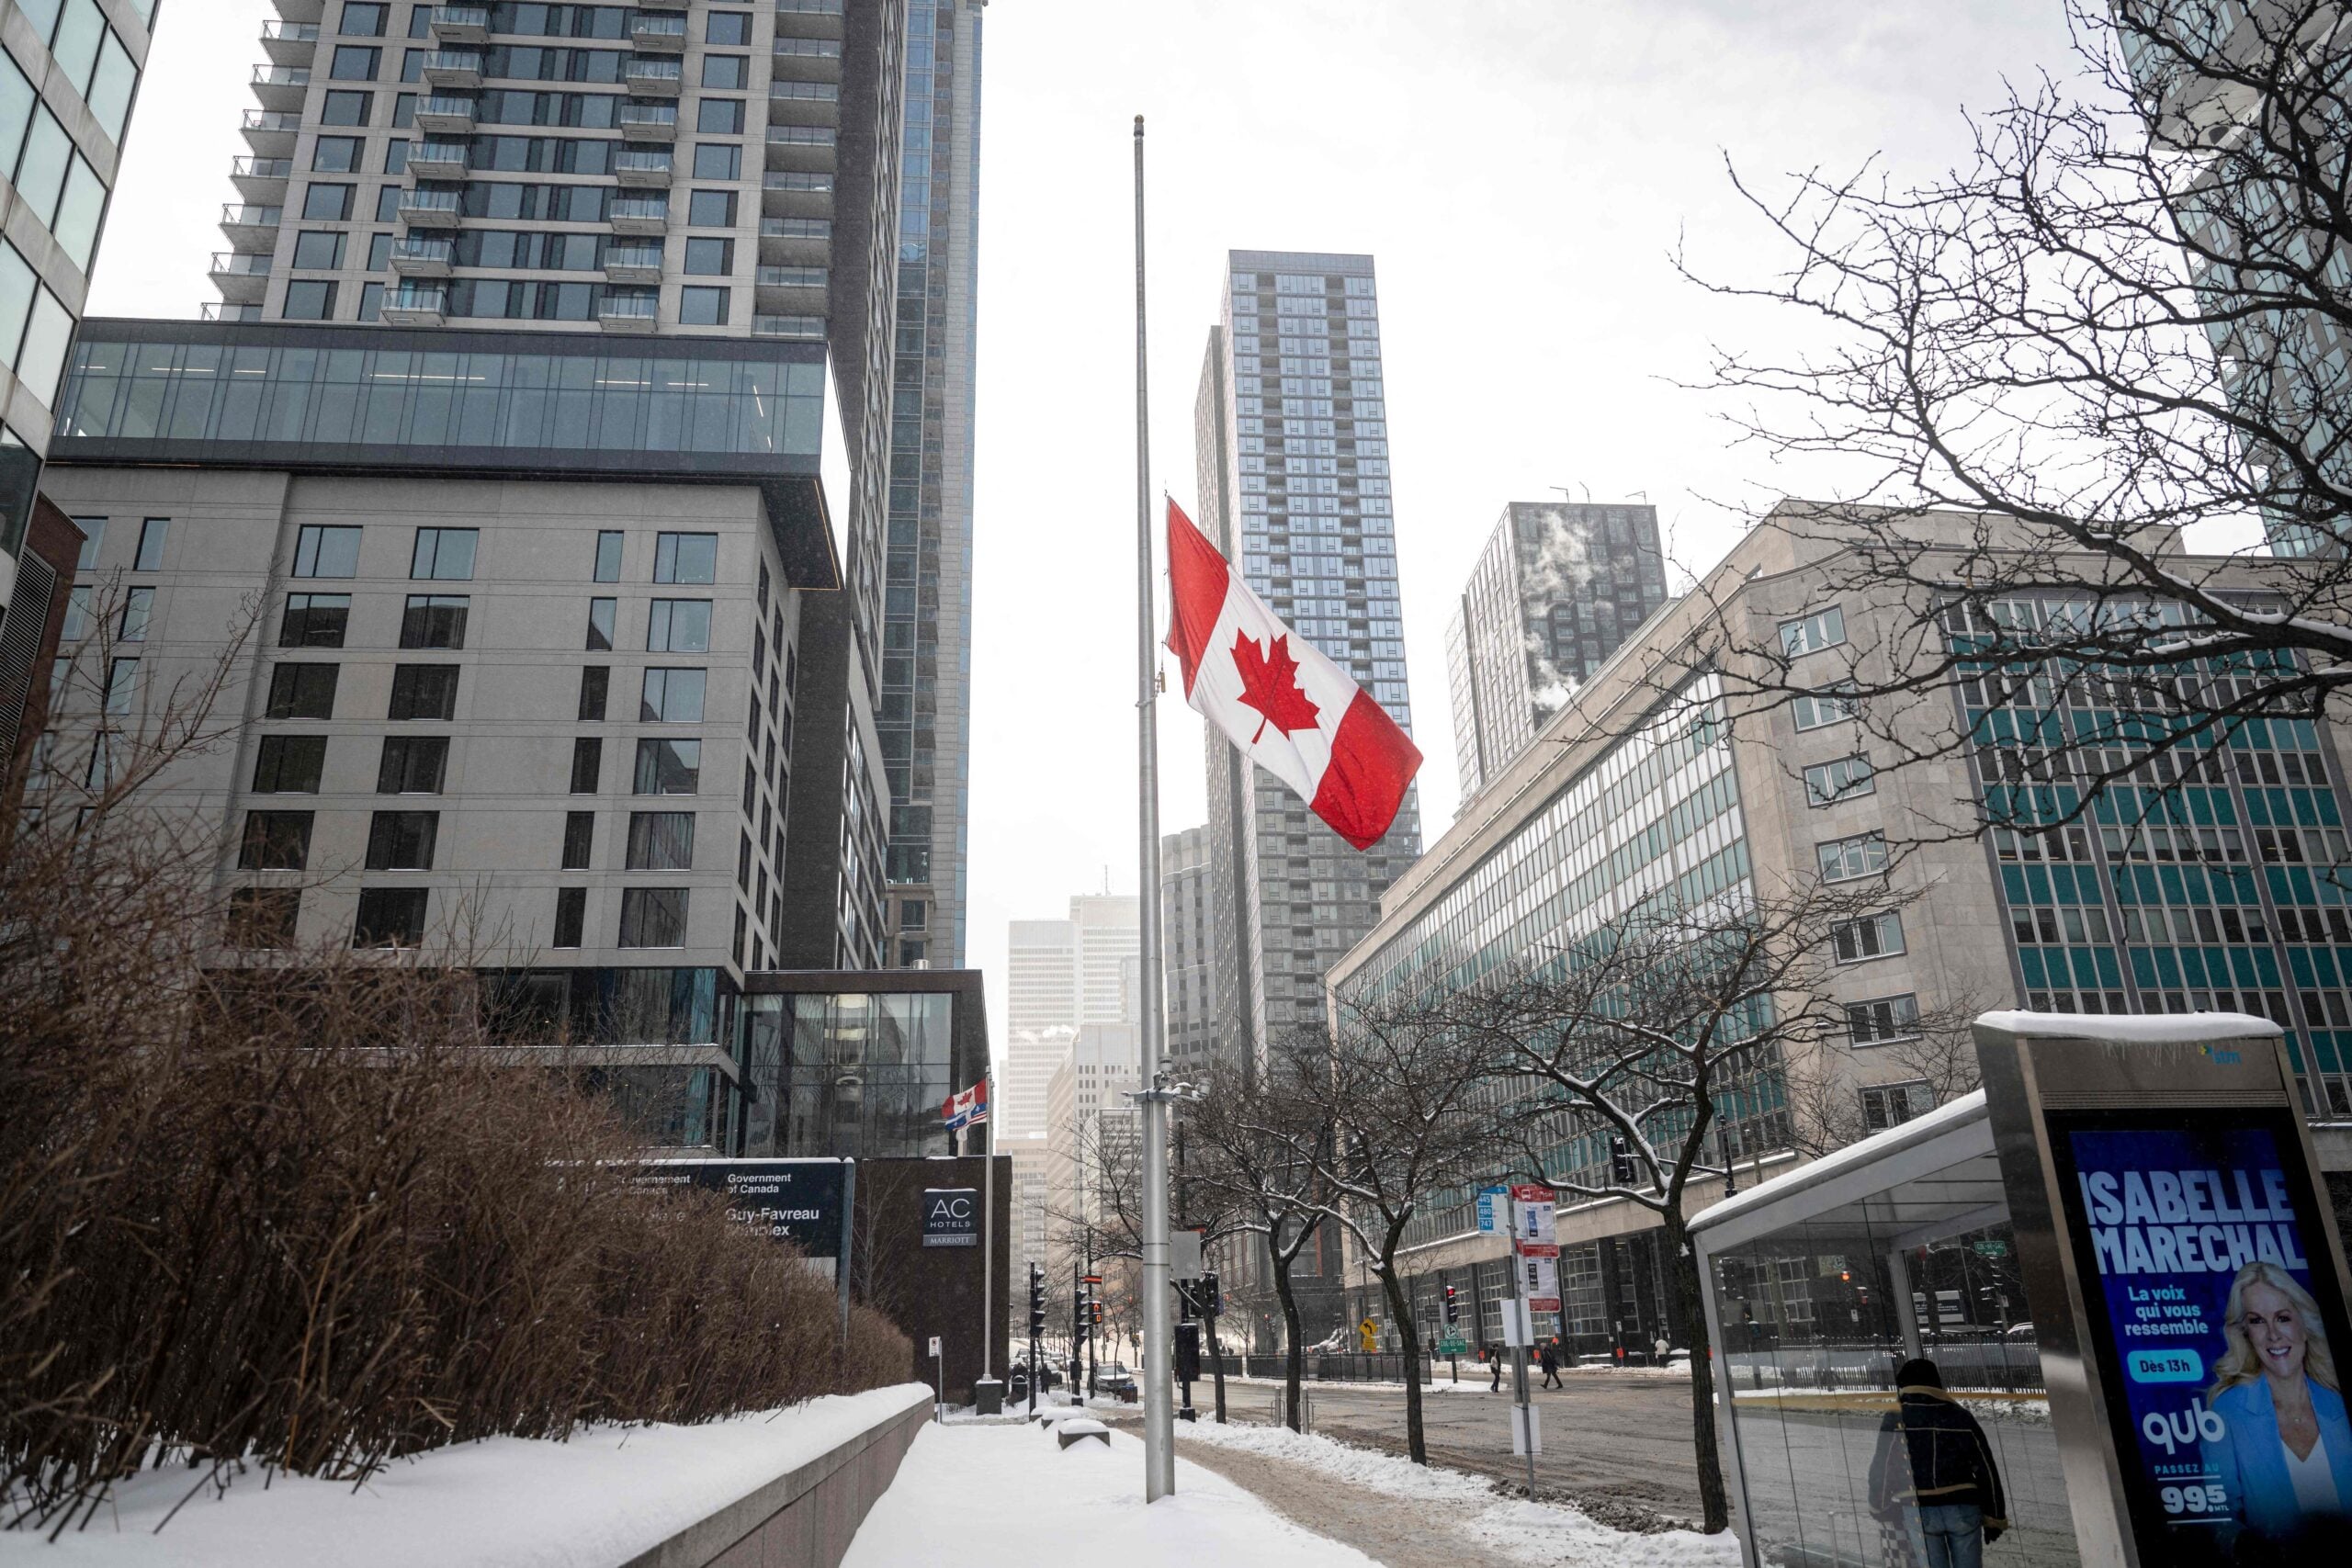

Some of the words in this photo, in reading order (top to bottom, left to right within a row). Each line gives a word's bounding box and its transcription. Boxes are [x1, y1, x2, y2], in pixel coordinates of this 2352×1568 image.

[728, 1174, 791, 1183] Government
[740, 1184, 779, 1193] Canada
[2077, 1169, 2296, 1224] ISABELLE
[726, 1208, 820, 1224] Guy-Favreau
[931, 1198, 970, 1218] AC
[2090, 1224, 2309, 1274] MARECHAL
[2128, 1286, 2150, 1301] La
[2151, 1284, 2186, 1301] voix
[2135, 1303, 2161, 1322] qui
[2163, 1305, 2201, 1317] vous
[2124, 1319, 2209, 1336] ressemble
[2140, 1359, 2165, 1373] Dès
[2143, 1397, 2224, 1455] qub
[2154, 1464, 2199, 1474] PASSEZ
[2205, 1462, 2220, 1472] AU
